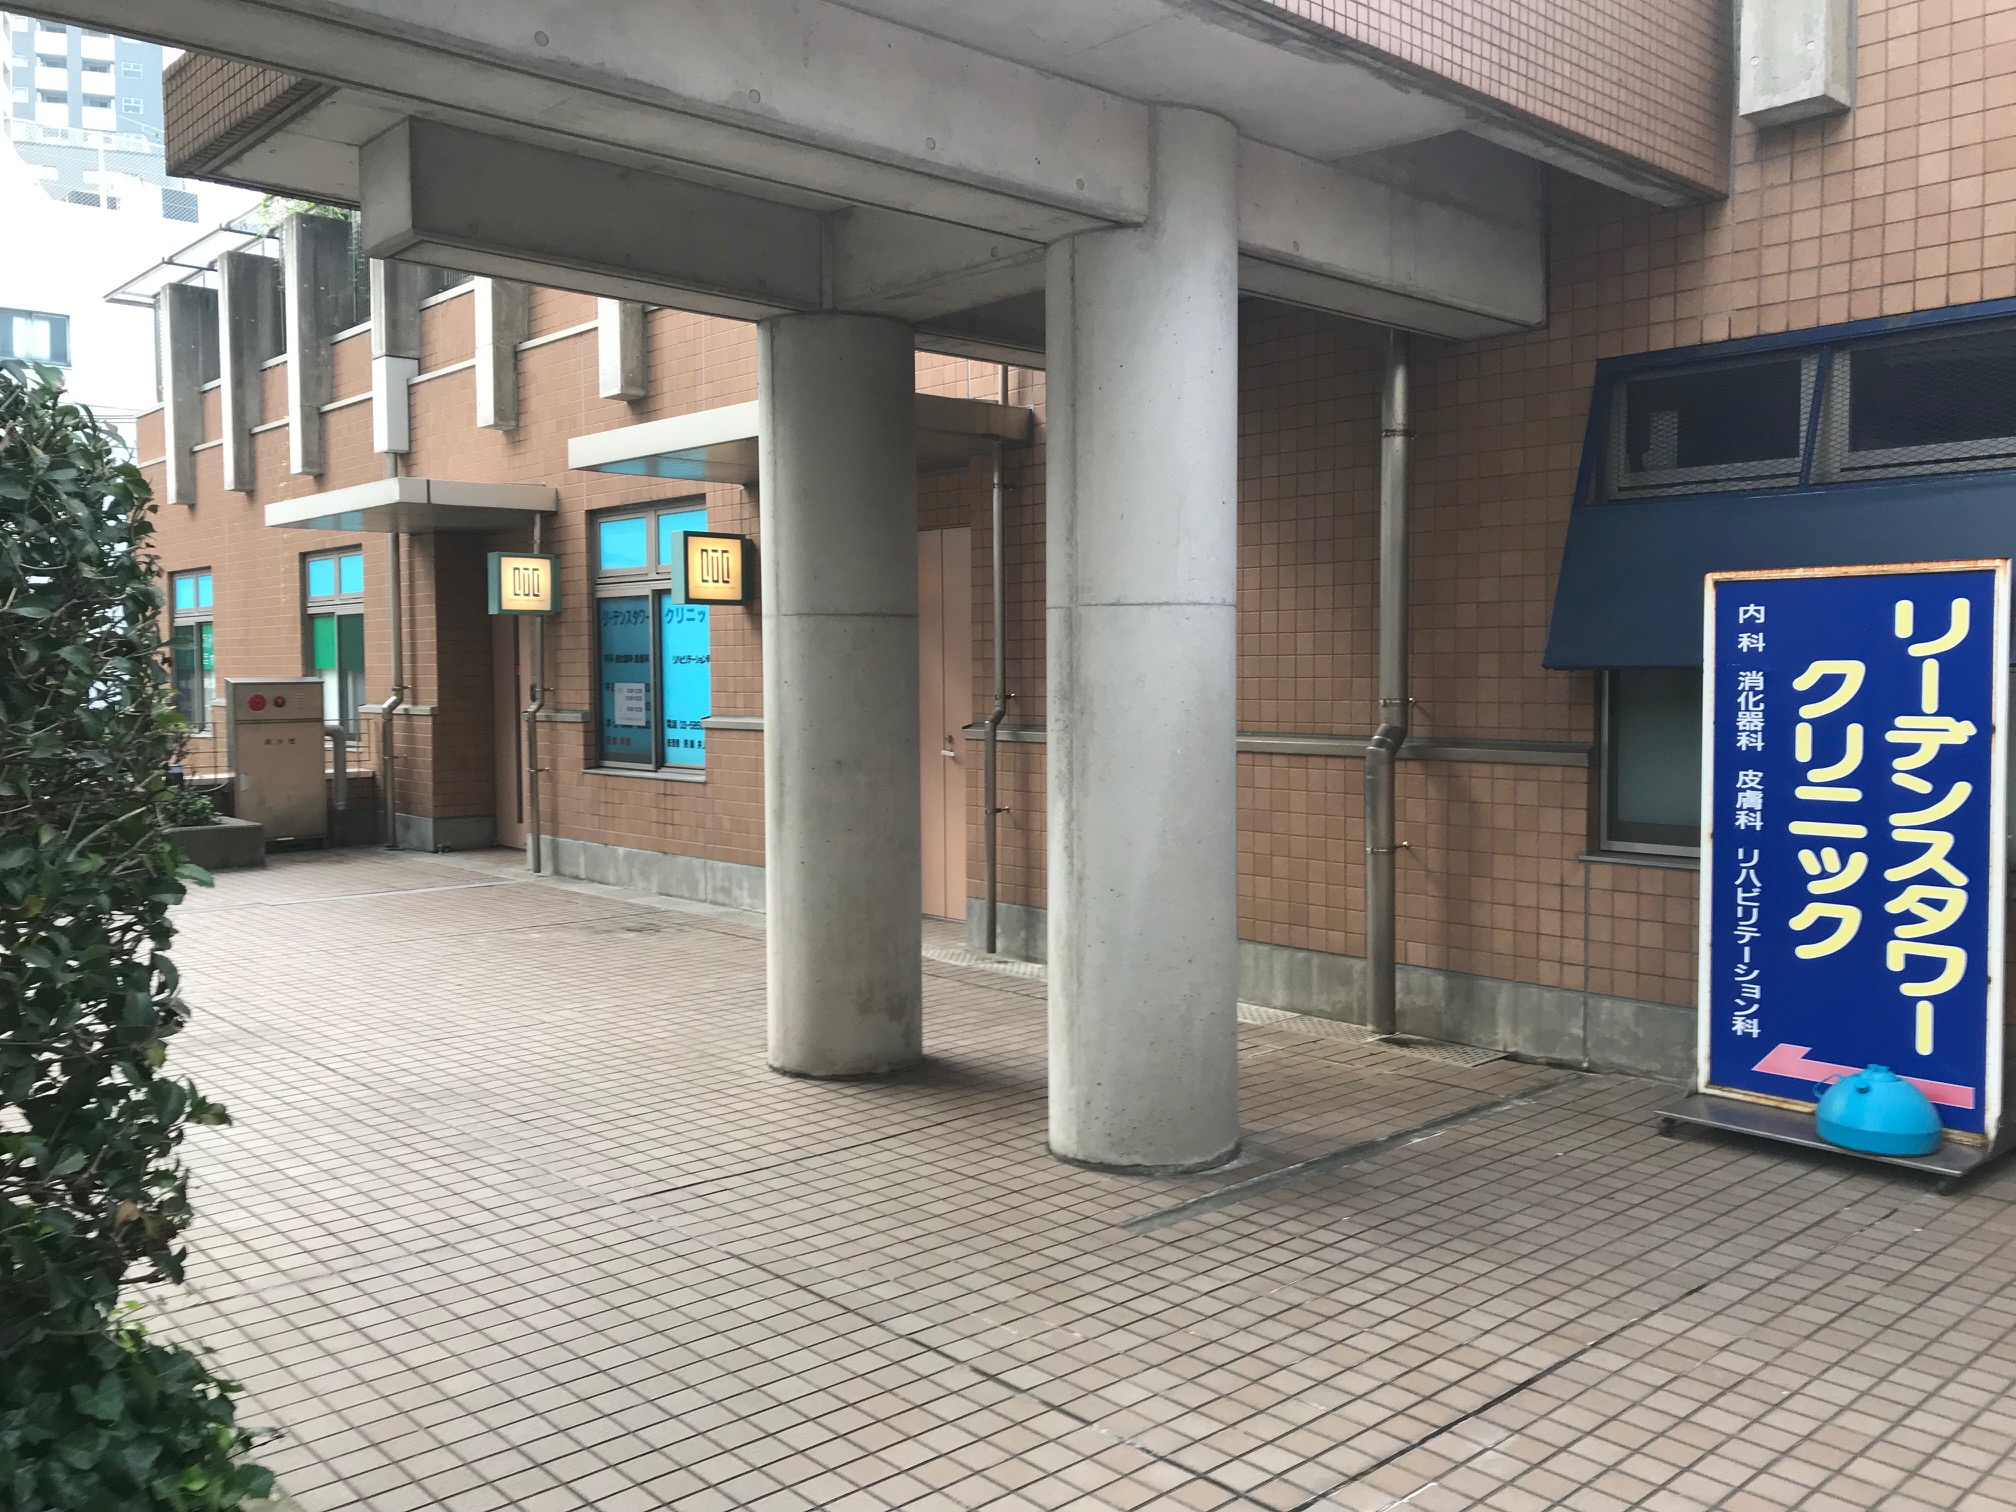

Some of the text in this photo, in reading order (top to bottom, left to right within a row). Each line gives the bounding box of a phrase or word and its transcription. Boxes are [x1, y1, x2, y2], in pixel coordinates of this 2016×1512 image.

[1731, 603, 1766, 1038] 内科 消化器科 皮膚科 リハビリテーション科
[1788, 660, 1869, 959] クリニック
[1884, 597, 1977, 1056] リーデンスタワー
